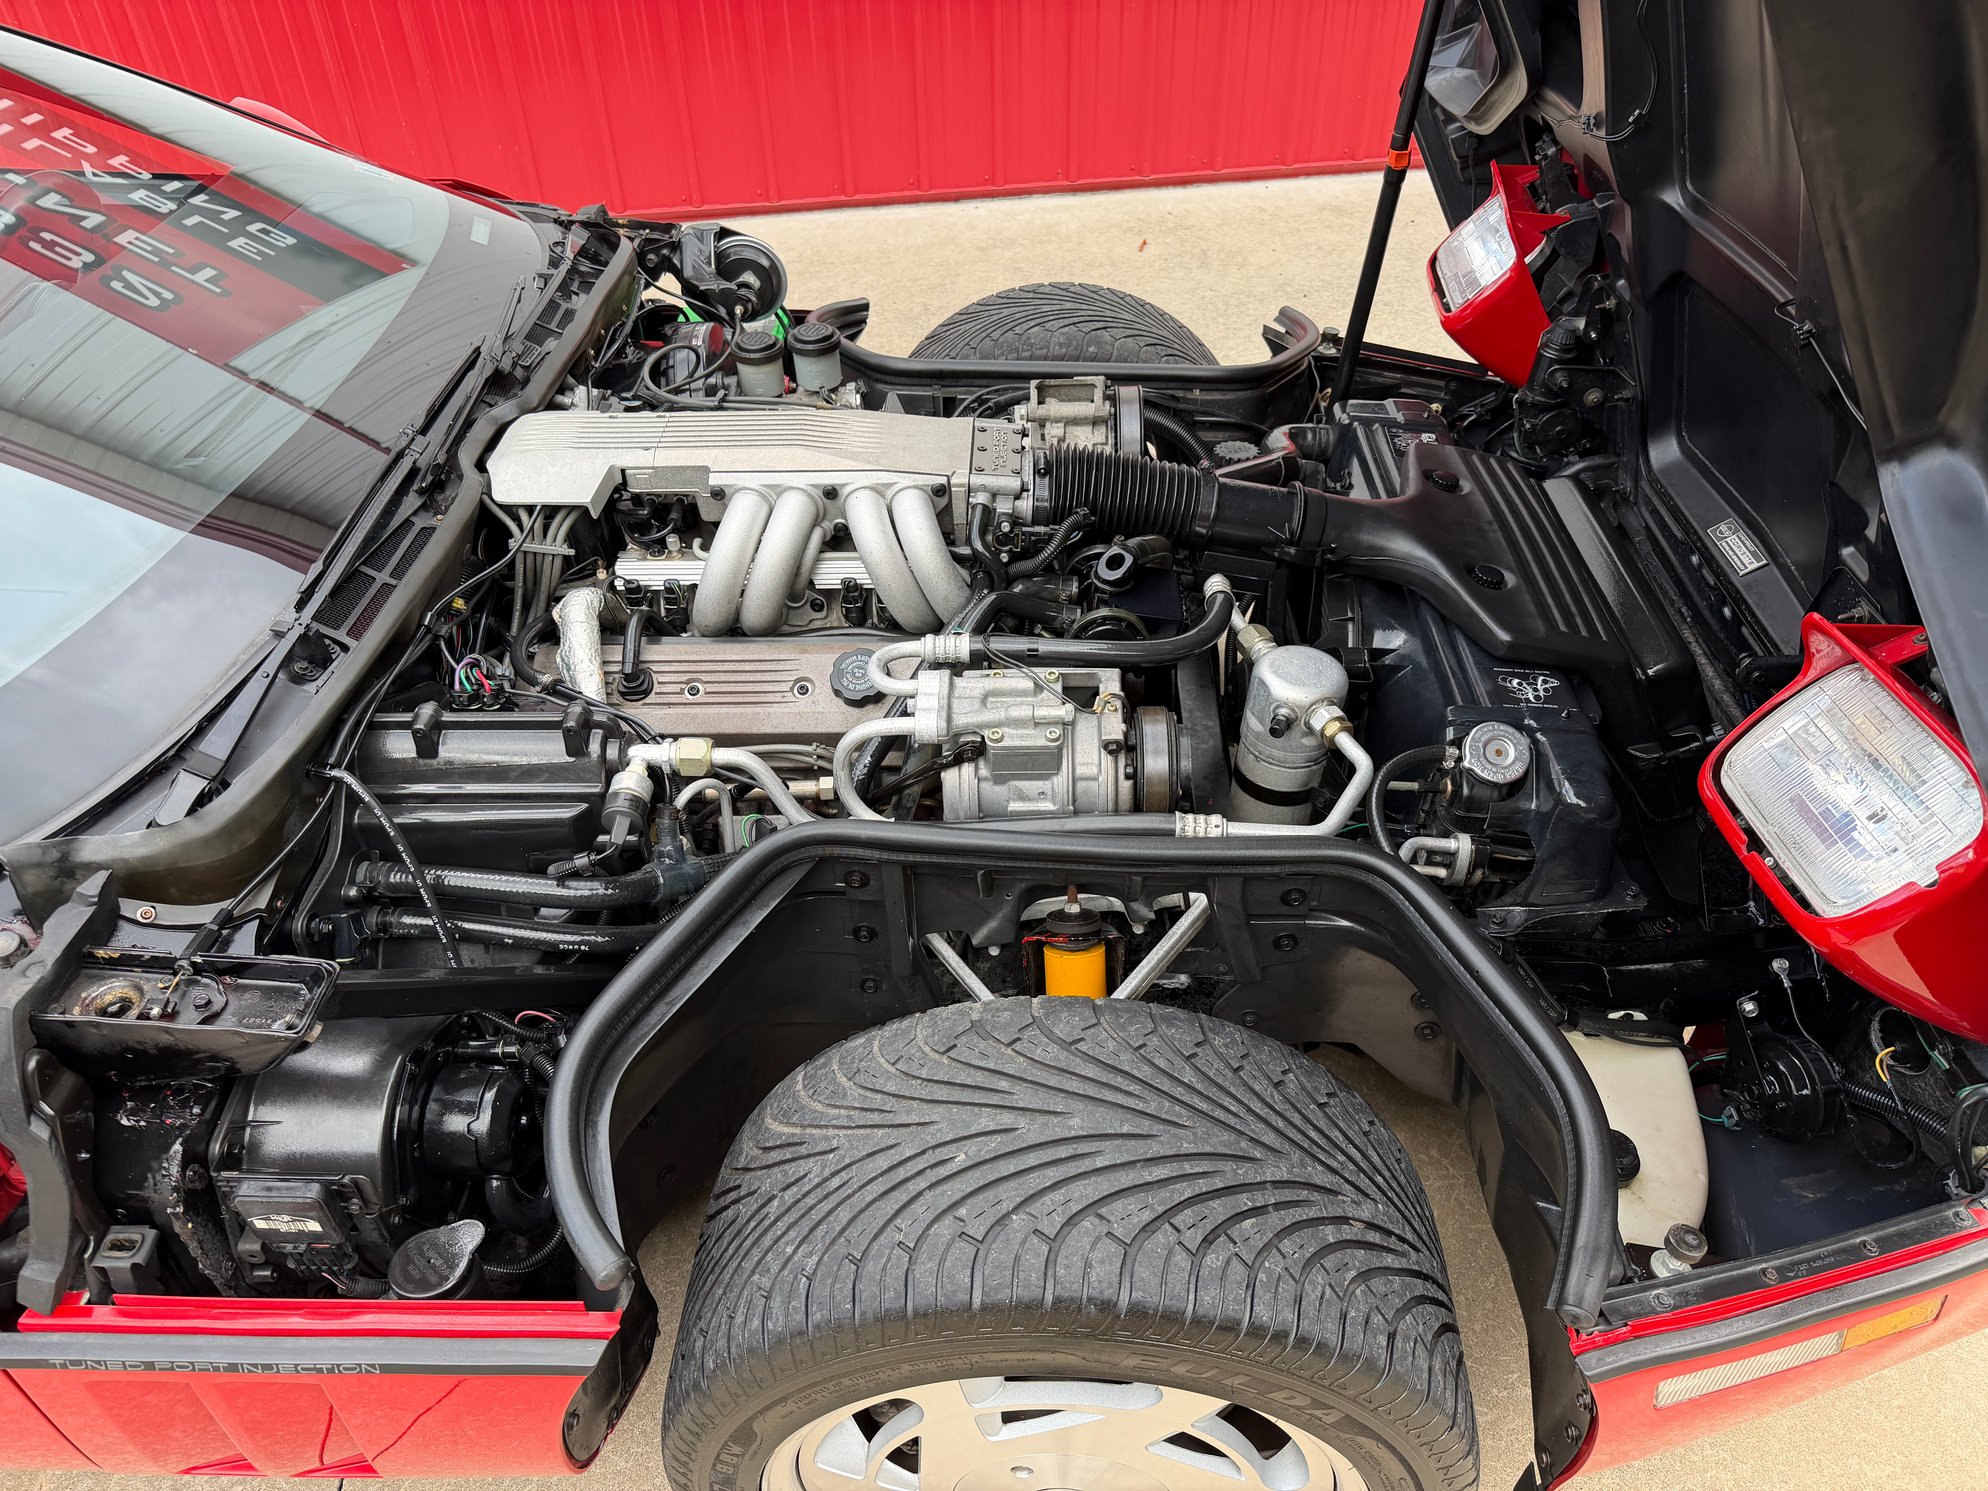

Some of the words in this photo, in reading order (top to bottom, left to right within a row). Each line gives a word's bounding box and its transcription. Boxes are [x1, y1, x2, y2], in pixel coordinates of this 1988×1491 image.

[1729, 538, 1755, 567] CORVETTE
[48, 1359, 145, 1371] TUNED
[153, 1360, 229, 1373] PORT
[237, 1362, 381, 1375] INJECTION
[1120, 1351, 1347, 1425] FULDA
